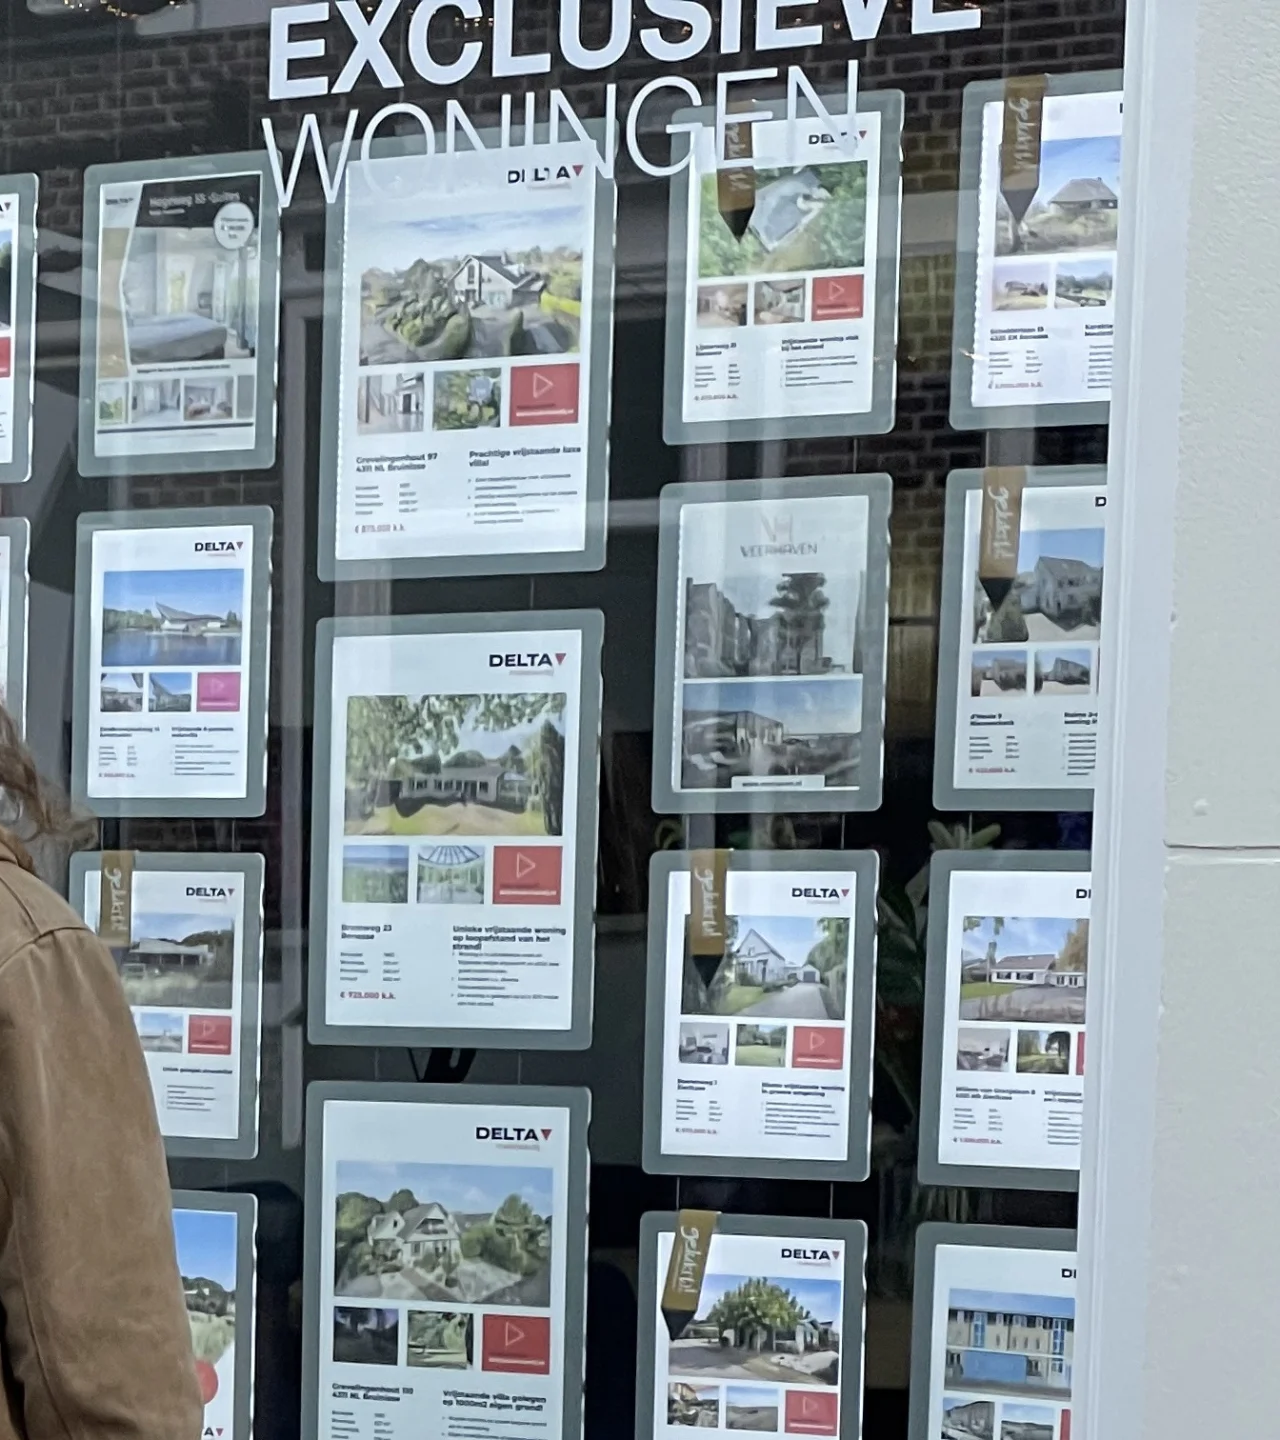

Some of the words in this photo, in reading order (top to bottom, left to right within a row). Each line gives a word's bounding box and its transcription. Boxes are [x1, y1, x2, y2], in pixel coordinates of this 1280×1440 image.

[261, 59, 860, 207] WONINGEN
[194, 541, 235, 551] DELTA
[489, 653, 553, 667] DELTA
[186, 887, 226, 897] DELTA
[792, 888, 840, 898] DELTA
[476, 1127, 539, 1141] DELTA
[781, 1248, 830, 1260] DELTA
